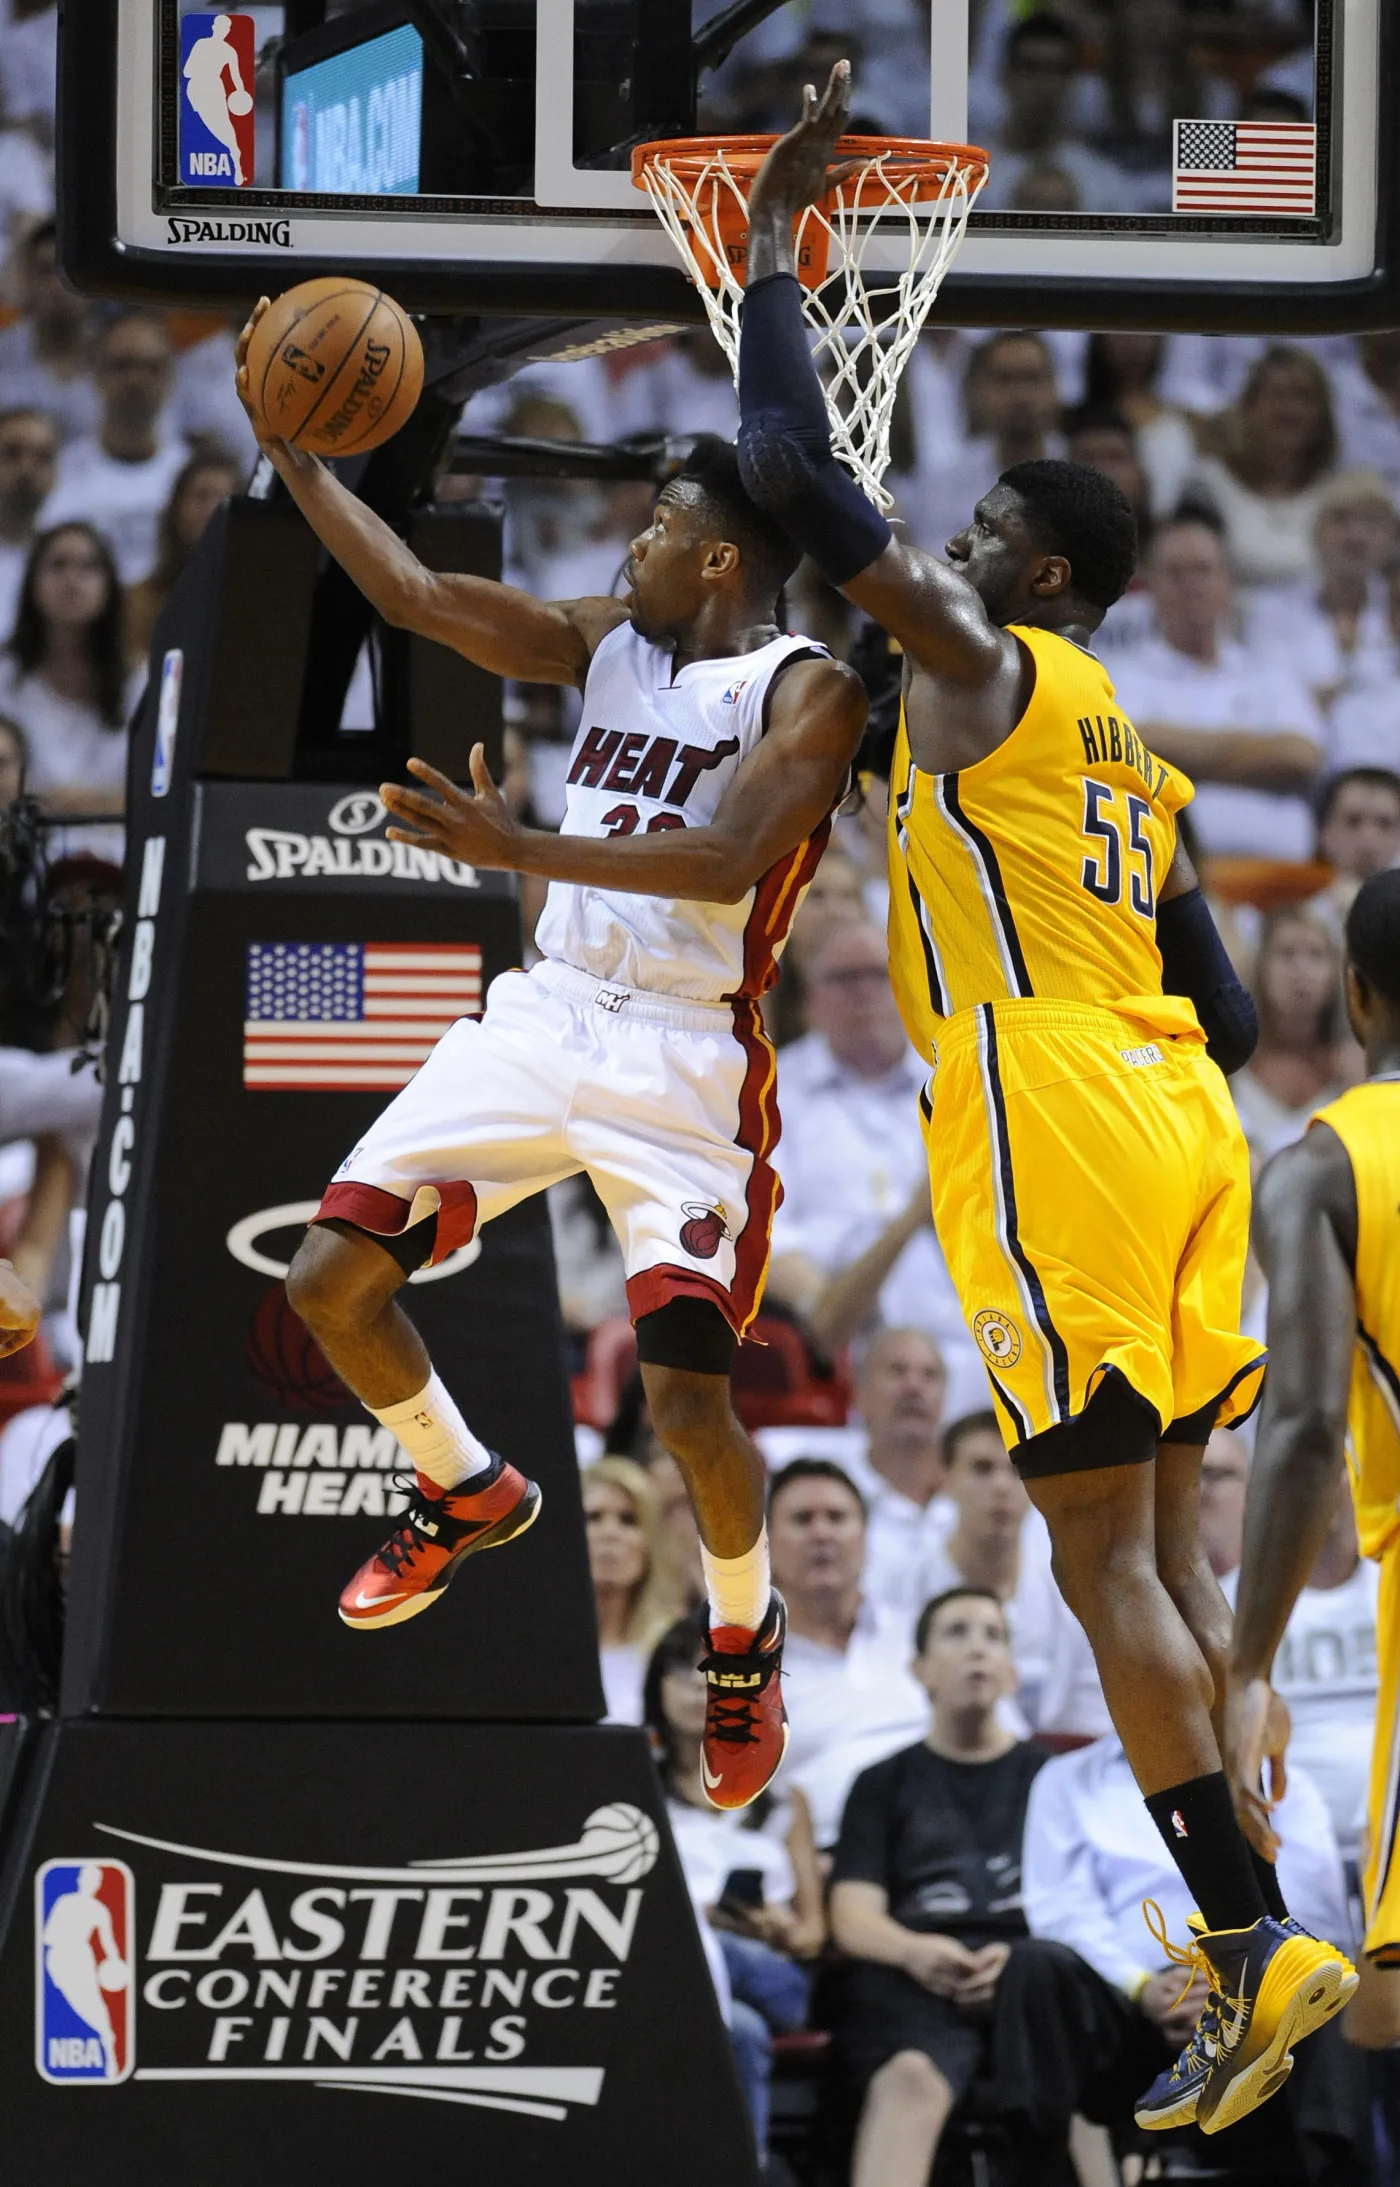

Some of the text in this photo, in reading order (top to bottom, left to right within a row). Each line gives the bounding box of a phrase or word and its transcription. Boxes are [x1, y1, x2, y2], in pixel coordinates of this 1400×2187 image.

[188, 152, 232, 177] NBA
[167, 217, 291, 248] SPALDING
[312, 337, 392, 444] SPALDING
[565, 725, 741, 808] HEAT
[1076, 714, 1170, 801] HIBBERT
[1081, 774, 1157, 922] 55
[255, 1470, 418, 1517] HEAT
[145, 1881, 644, 1962] EASTERN
[142, 1967, 622, 2009] CONFERENCE
[48, 2036, 104, 2069] NBA
[206, 2014, 528, 2061] FINALS
